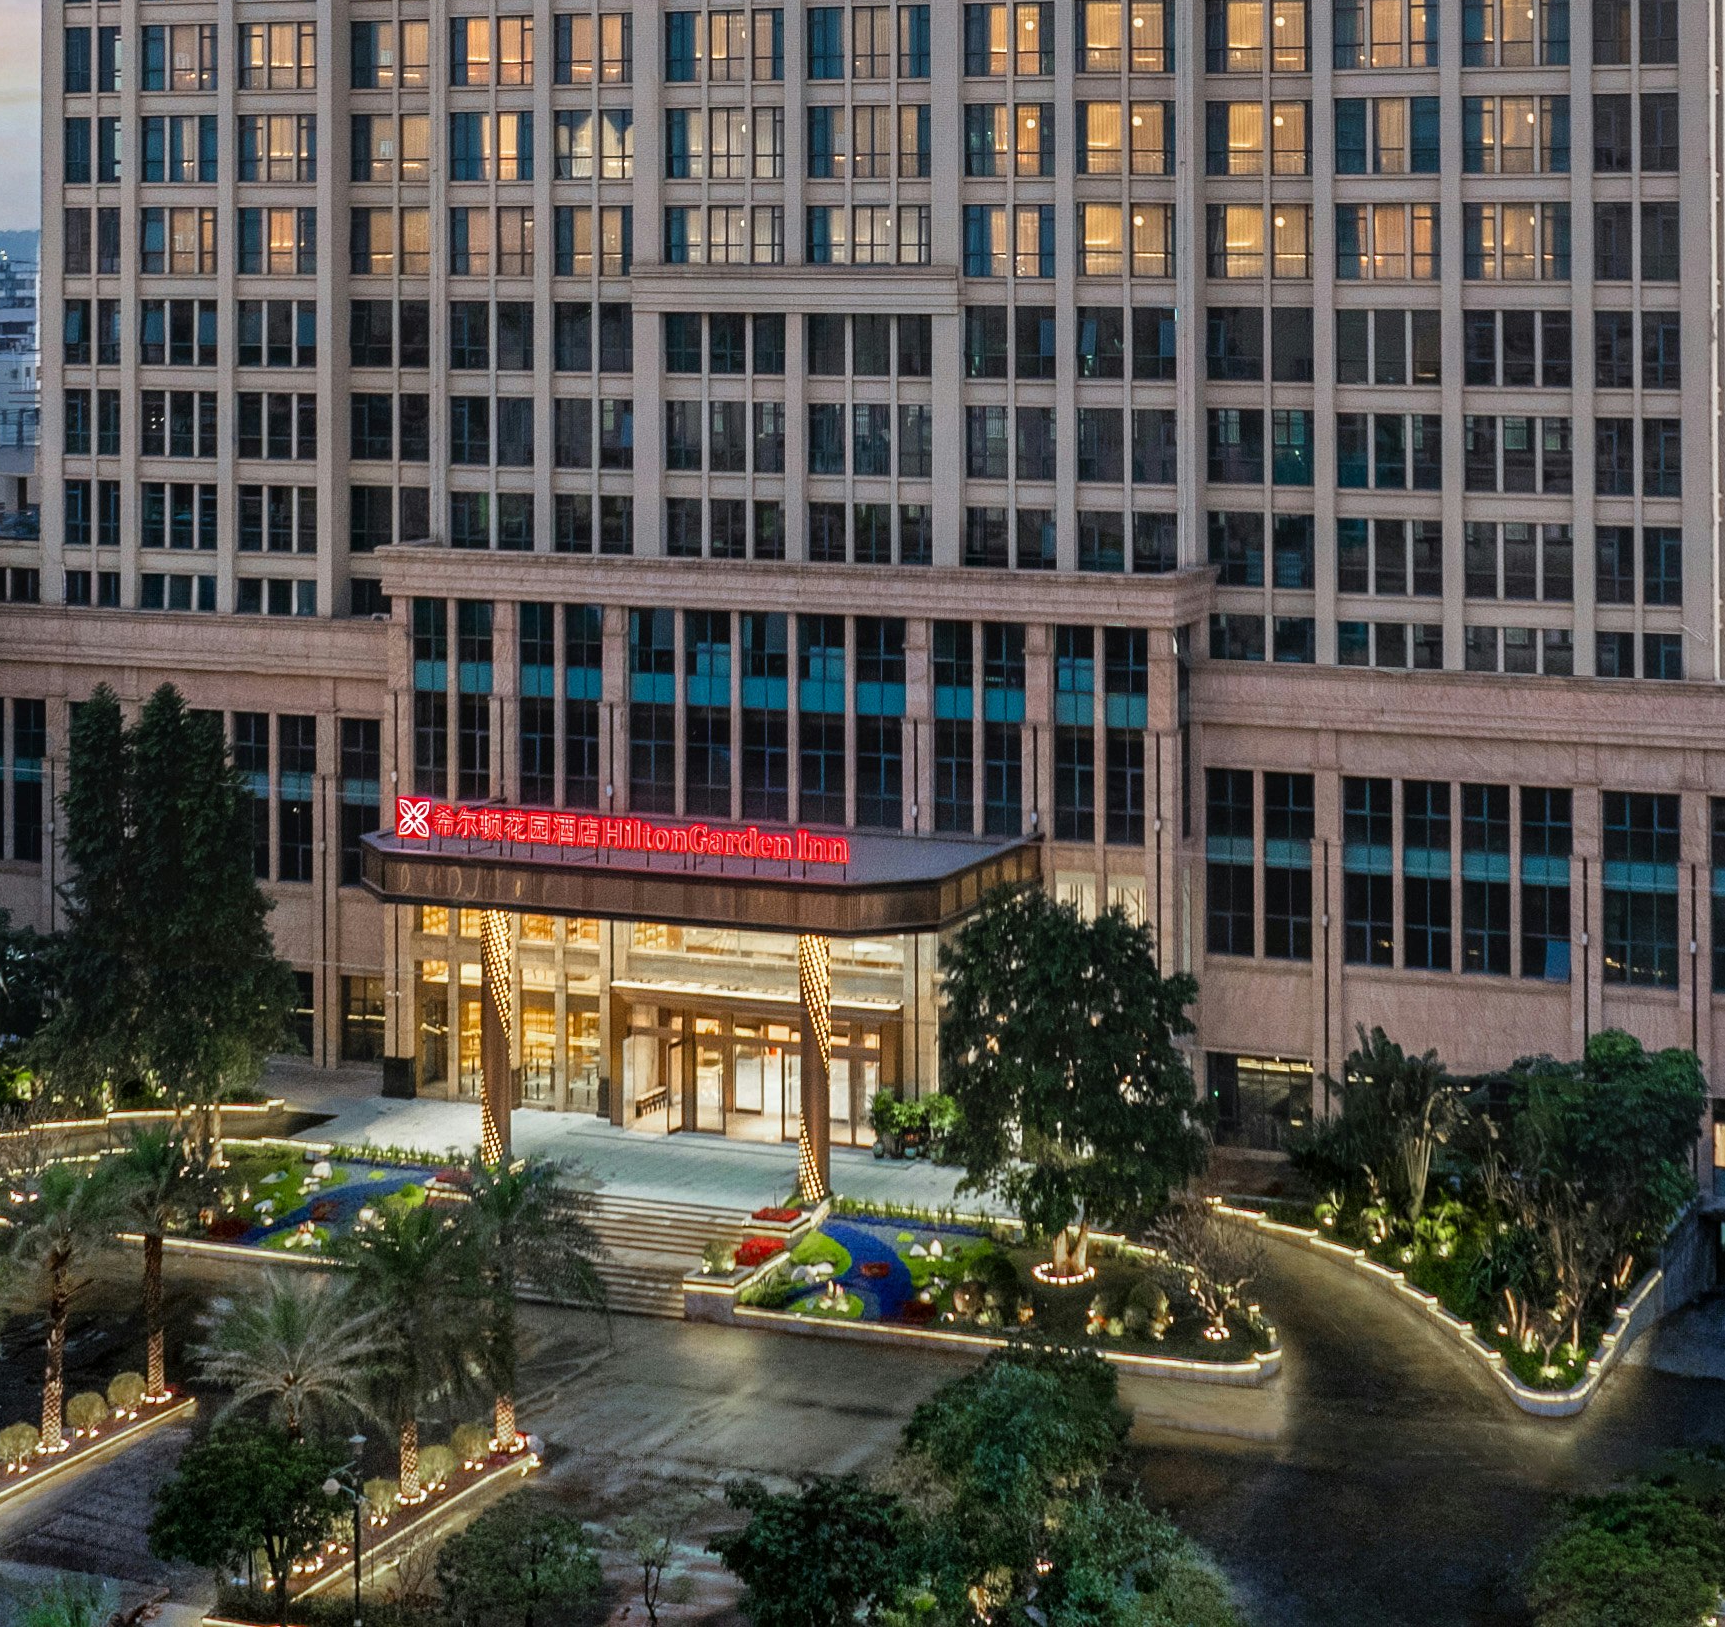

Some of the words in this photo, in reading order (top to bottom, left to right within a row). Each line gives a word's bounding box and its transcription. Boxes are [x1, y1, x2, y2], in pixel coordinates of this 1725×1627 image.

[432, 804, 600, 849] 希尔顿花园酒店
[796, 829, 850, 863] Inn
